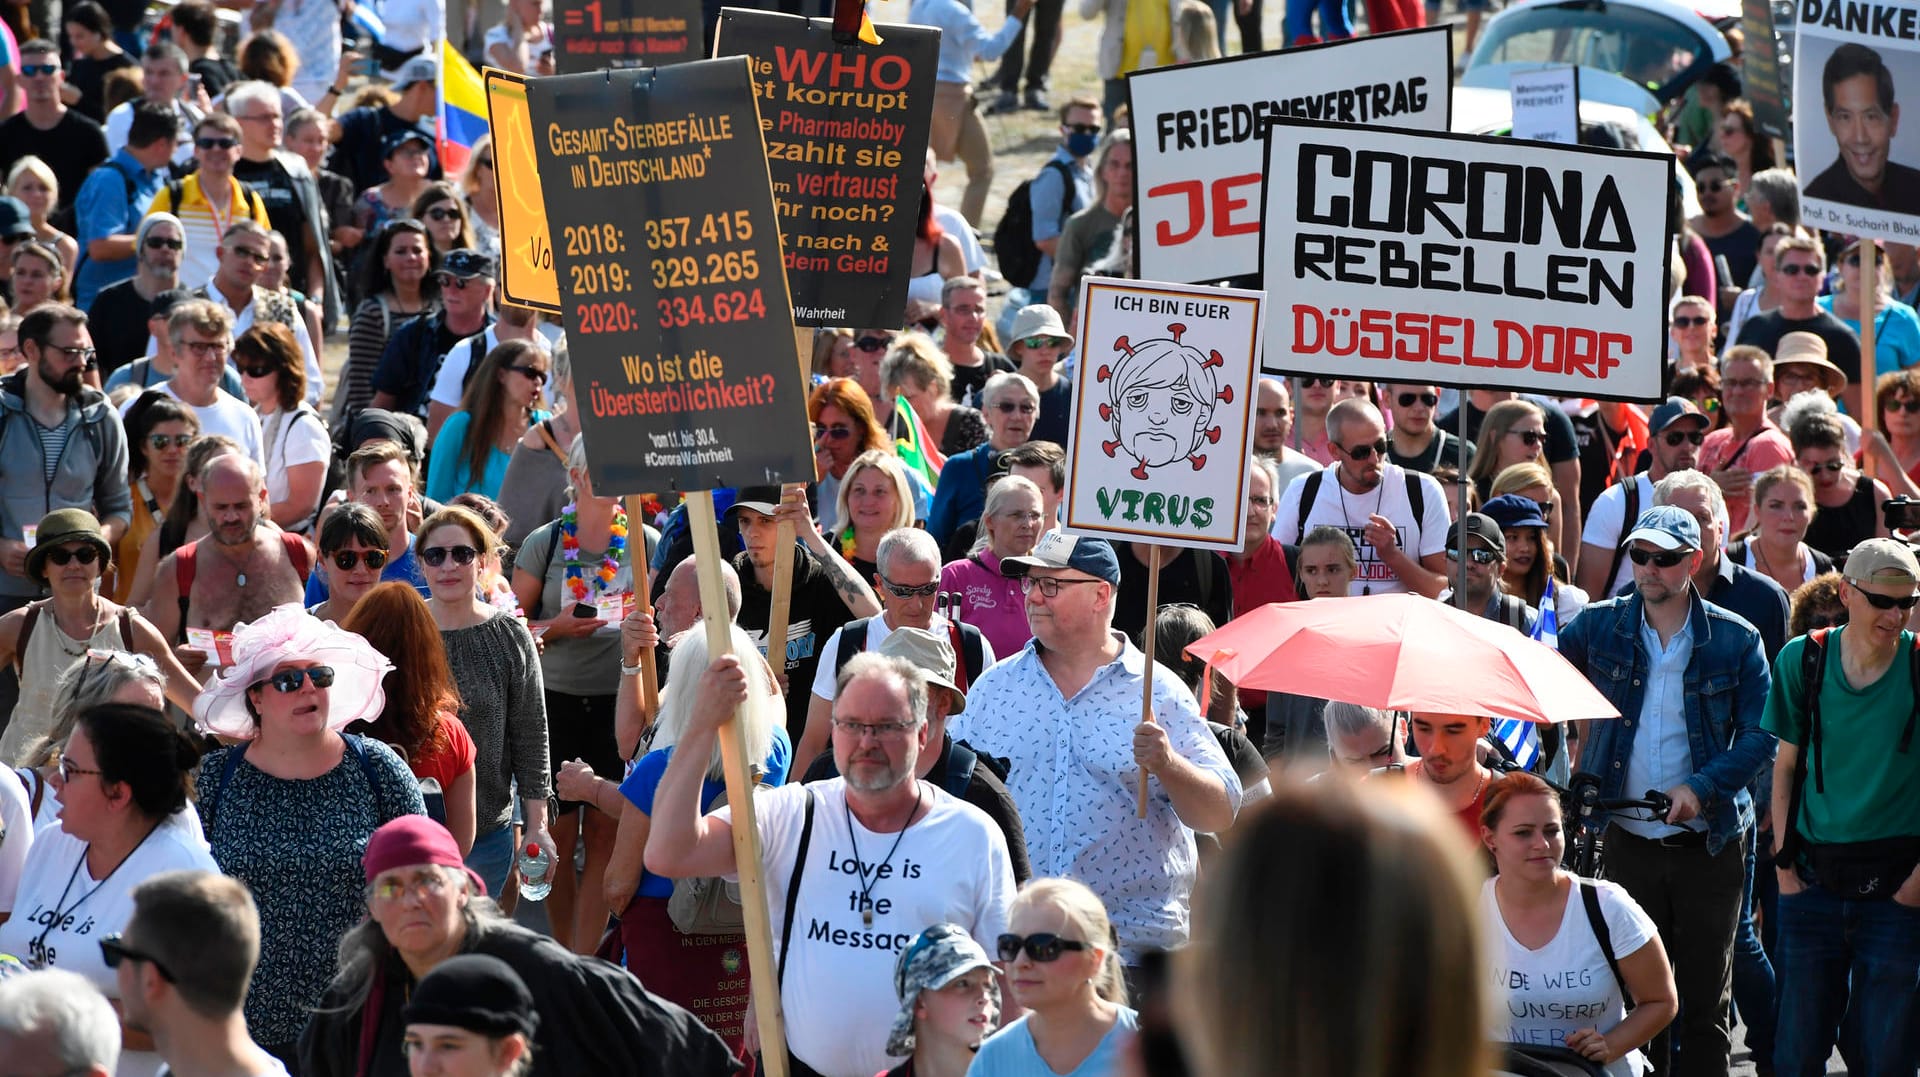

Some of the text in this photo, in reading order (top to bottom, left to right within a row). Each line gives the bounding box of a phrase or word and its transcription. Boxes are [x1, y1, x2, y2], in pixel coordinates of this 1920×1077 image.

[774, 46, 912, 91] WHO
[753, 80, 909, 113] st korrupt
[778, 110, 905, 147] Pharmalobby
[766, 140, 902, 168] zahlt sie
[796, 170, 899, 200] vertraust
[1296, 143, 1637, 253] CORONA
[810, 203, 896, 223] noch?
[564, 223, 626, 256] 2018:
[645, 210, 753, 250] 357.415
[797, 234, 862, 251] nach
[870, 235, 889, 252] &
[530, 236, 555, 271] Vo
[836, 255, 889, 274] Geld
[570, 250, 760, 295] 2019: 329.265
[1294, 232, 1635, 309] REBELLEN
[577, 288, 766, 334] 2020: 334.624
[1114, 295, 1230, 320] ICH BIN EUER
[1291, 304, 1633, 379] DÜSSELDORF
[621, 350, 723, 385] Wo ist die
[590, 373, 776, 418] Übersterblichkeit?
[680, 429, 695, 447] bis
[695, 427, 719, 446] 30.4.
[1096, 487, 1214, 531] VIRUS
[829, 850, 921, 879] Love is
[849, 890, 892, 915] the
[28, 904, 95, 935] Love is
[718, 979, 746, 991] SUCHE
[1543, 967, 1592, 989] WEG
[693, 998, 711, 1009] DIE
[716, 1011, 733, 1023] DER
[1507, 997, 1610, 1020] UNSEREN
